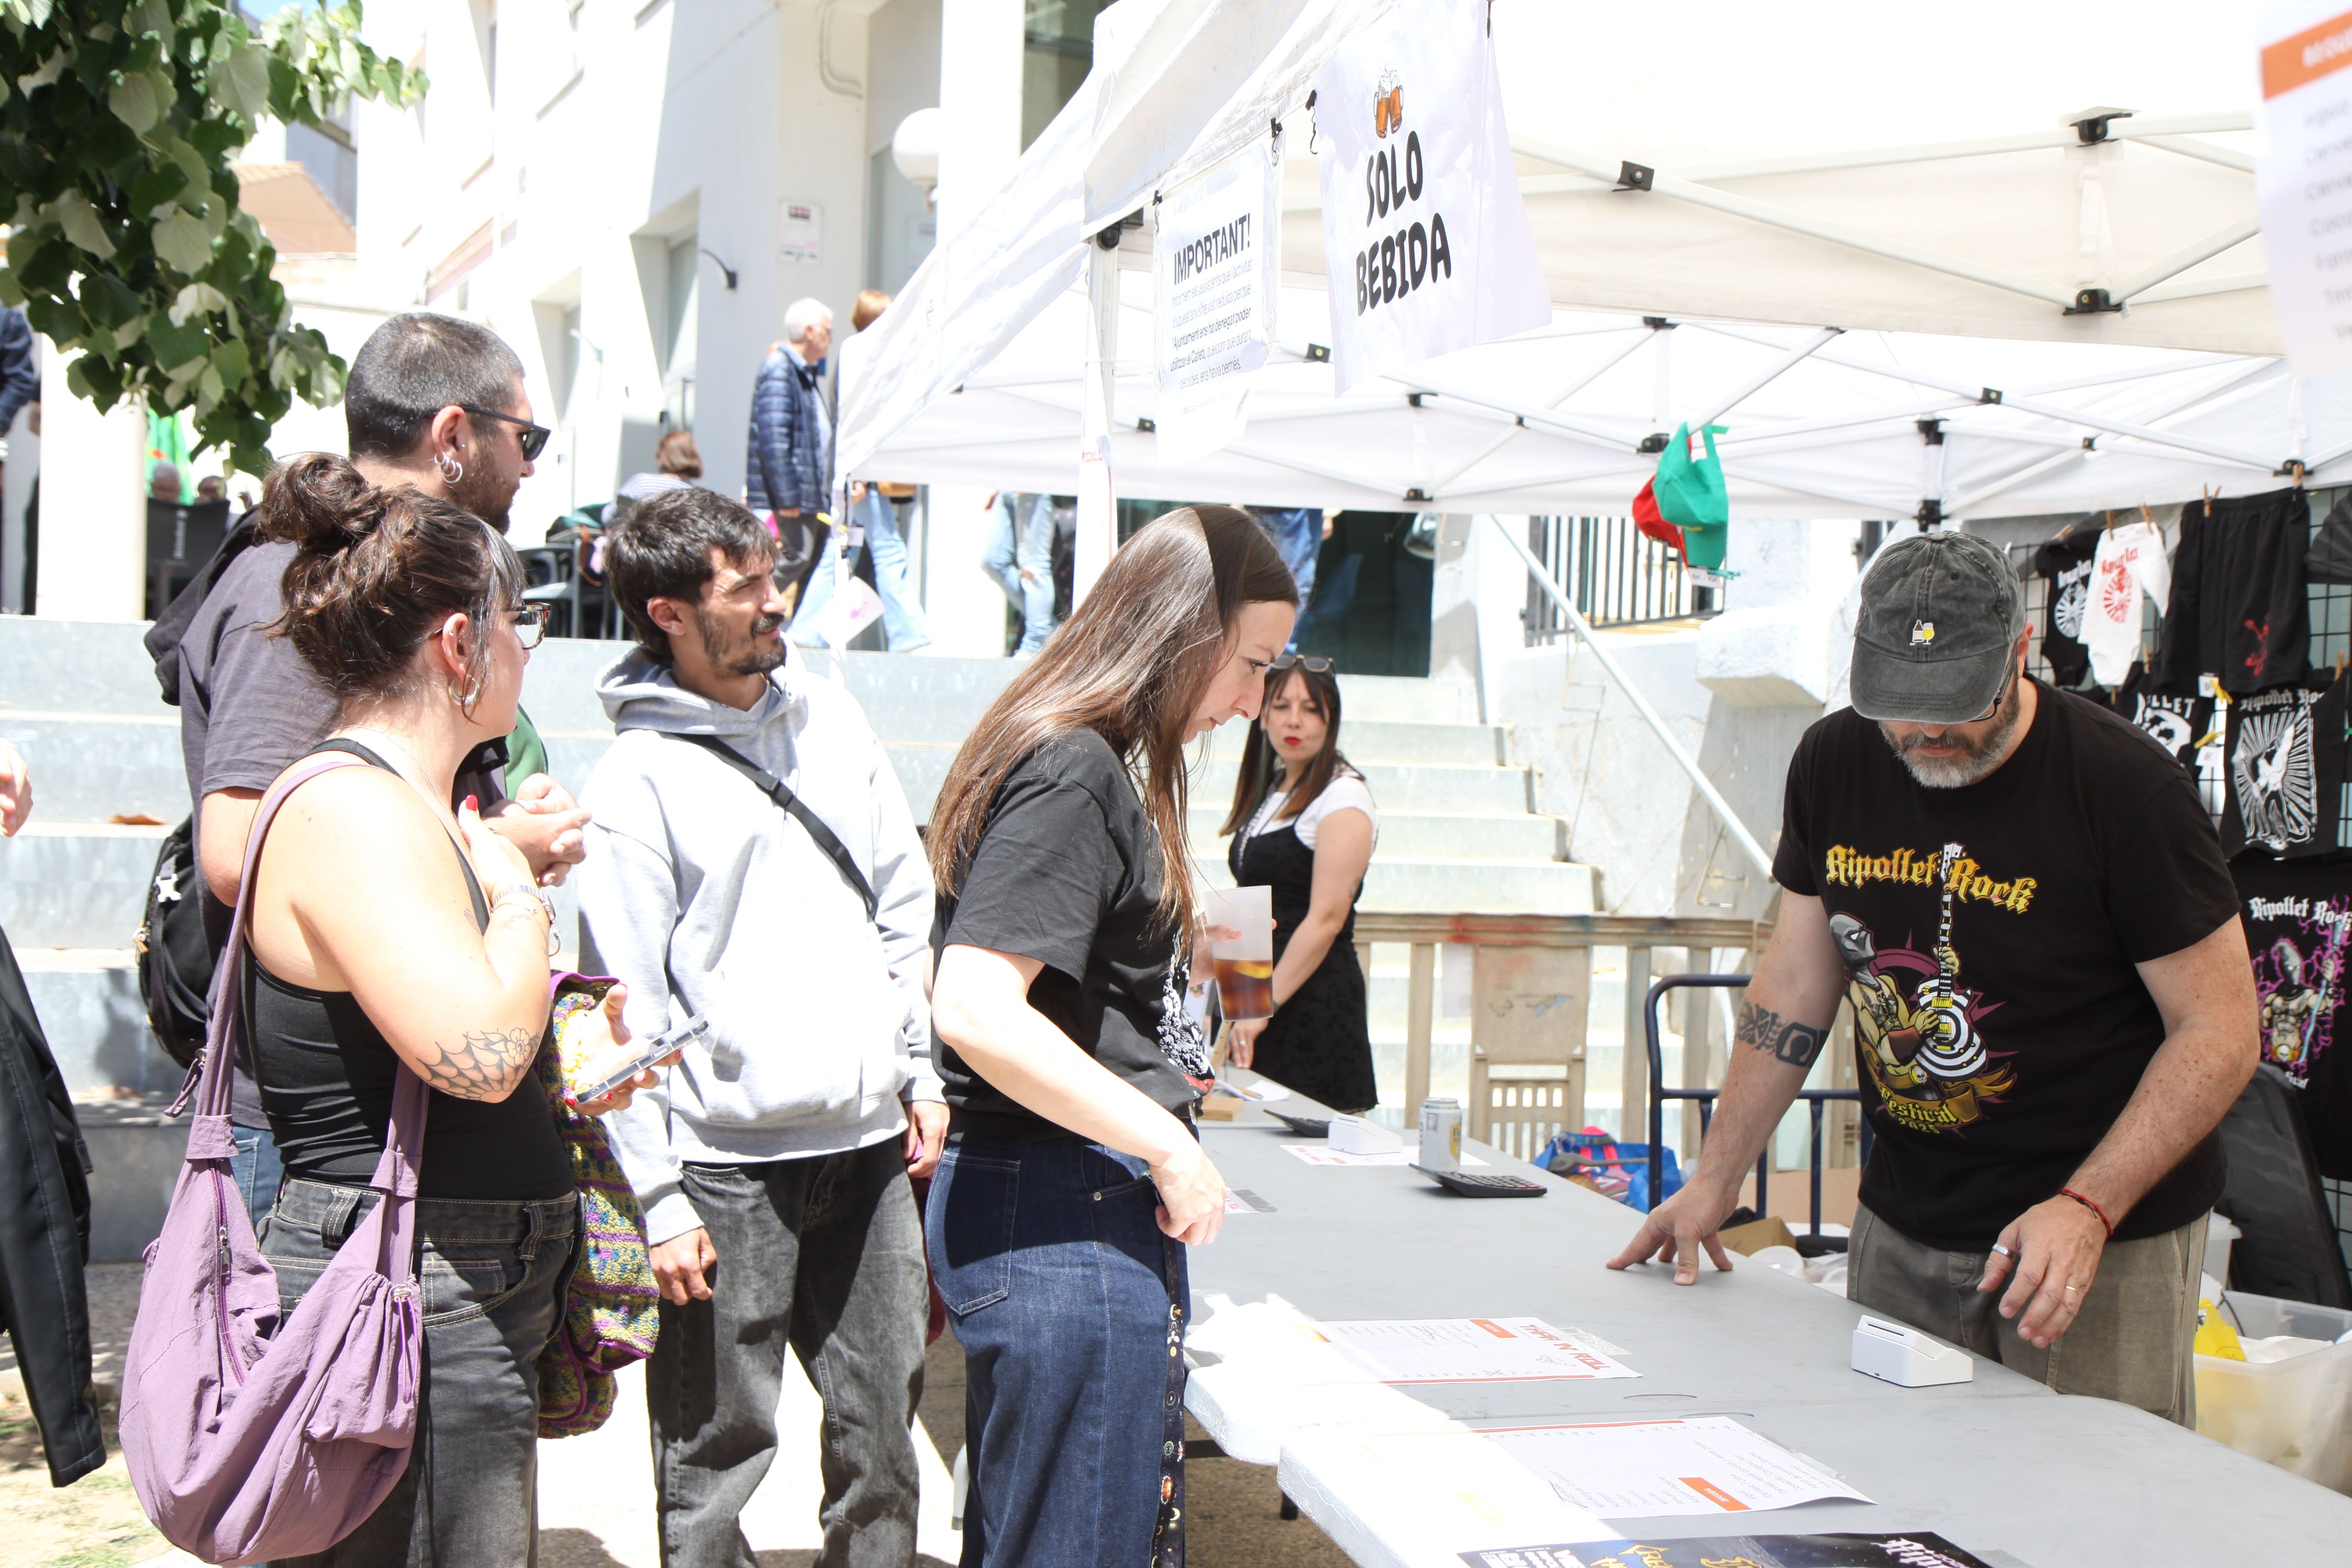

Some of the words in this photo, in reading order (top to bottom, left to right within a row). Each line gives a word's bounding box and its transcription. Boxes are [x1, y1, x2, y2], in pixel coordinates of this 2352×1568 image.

[1365, 130, 1423, 227] SOLO
[1174, 213, 1252, 286] IMPORTANT!
[1356, 213, 1452, 317] BEBIDA
[1198, 272, 1221, 294] assistents
[1222, 270, 1230, 287] que
[1208, 319, 1214, 334] ha
[1215, 311, 1234, 334] denegat
[1235, 303, 1251, 325] poder
[1170, 353, 1186, 373] utilitzar
[1187, 350, 1190, 365] el
[1207, 338, 1225, 361] quelcom
[1236, 326, 1251, 347] durant
[1200, 369, 1208, 384] ens
[1826, 843, 1941, 887] Ripollet
[1944, 857, 2037, 914] Rock
[2248, 895, 2309, 922] Ripollet
[1878, 1083, 1960, 1125] Festival
[1898, 1117, 1940, 1134] 2025
[1519, 1325, 1561, 1339] TAPA
[1570, 1354, 1612, 1369] ROLL
[1691, 1440, 1713, 1449] gluten
[1707, 1450, 1726, 1459] sense
[1725, 1462, 1751, 1472] alcohol
[1747, 1485, 1773, 1497] Cervesa
[1761, 1482, 1789, 1493] Cervesa
[1798, 1479, 1820, 1488] Fanta
[1703, 1488, 1729, 1501] BEGUDA
[1736, 1490, 1759, 1499] Aigua
